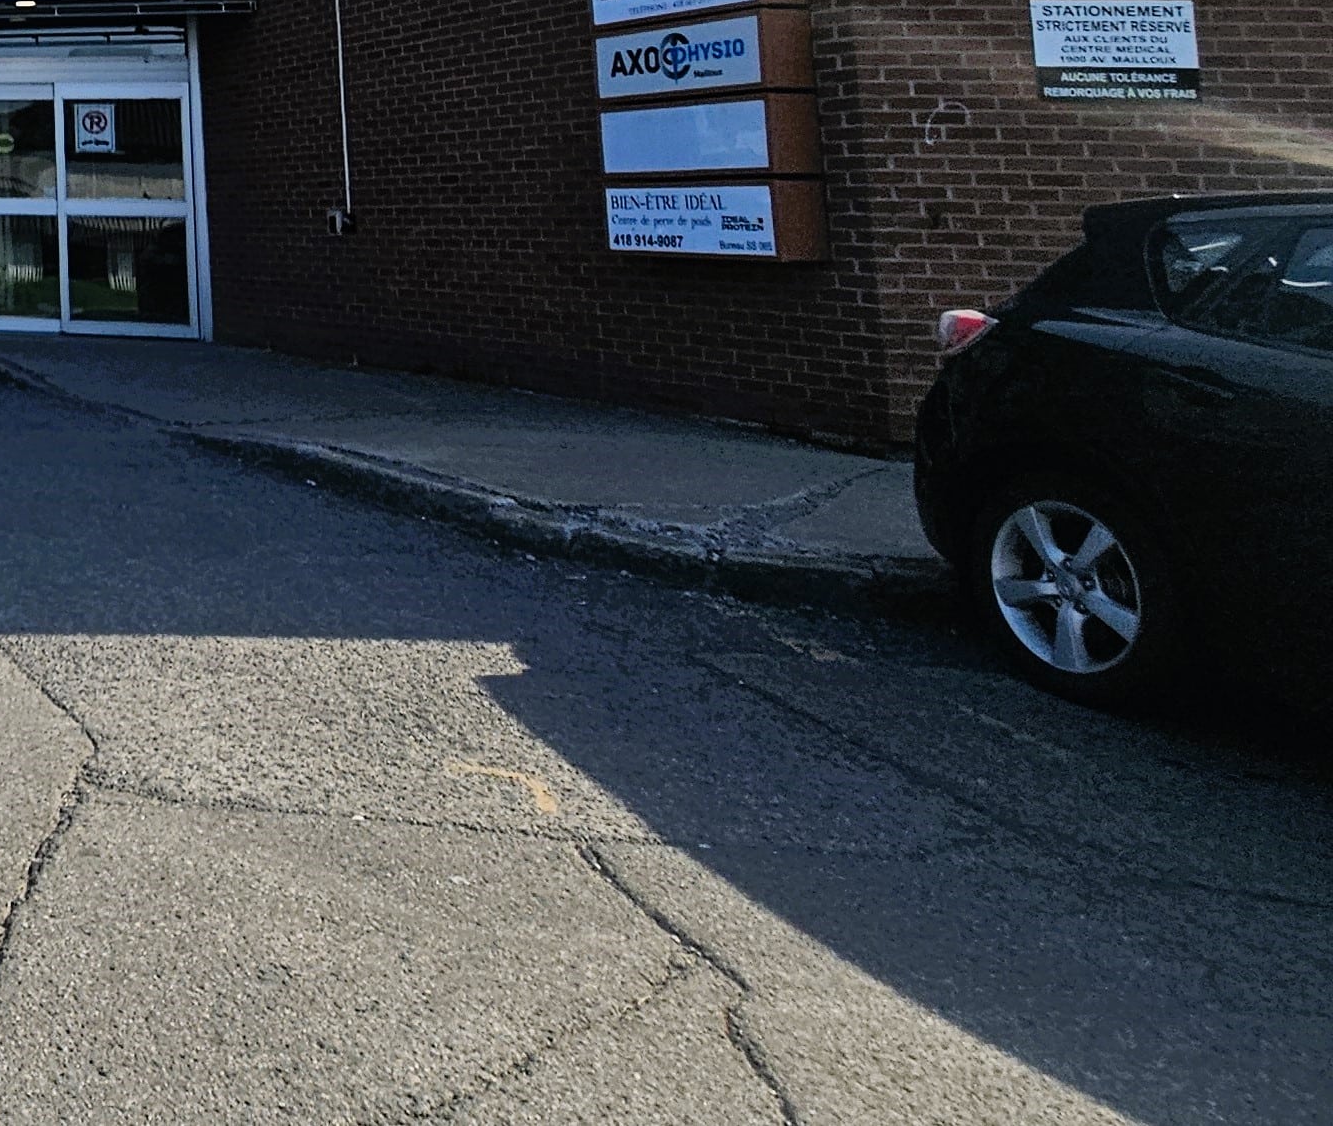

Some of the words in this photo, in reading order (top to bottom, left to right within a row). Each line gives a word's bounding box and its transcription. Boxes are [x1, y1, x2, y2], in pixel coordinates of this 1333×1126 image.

[1042, 5, 1184, 17] STATIONNEMENT
[1036, 20, 1126, 32] STRICTEMENT
[1132, 18, 1192, 33] RÉSERVÉ
[1064, 35, 1088, 43] AUX
[1093, 35, 1146, 44] CLIENTS
[1150, 35, 1168, 44] DU
[1061, 45, 1112, 53] CENTRE
[1112, 56, 1177, 64] MAILLOUX
[1061, 72, 1108, 82] AUCUNE
[1110, 71, 1178, 83] TOLÉRANCE
[1043, 86, 1125, 98] REMORQUAGE
[1138, 88, 1161, 98] VOS
[1164, 88, 1197, 99] FRAIS
[611, 192, 680, 210] BIEN-ÊTRE
[614, 234, 632, 246] 418
[634, 234, 683, 247] 914-9087
